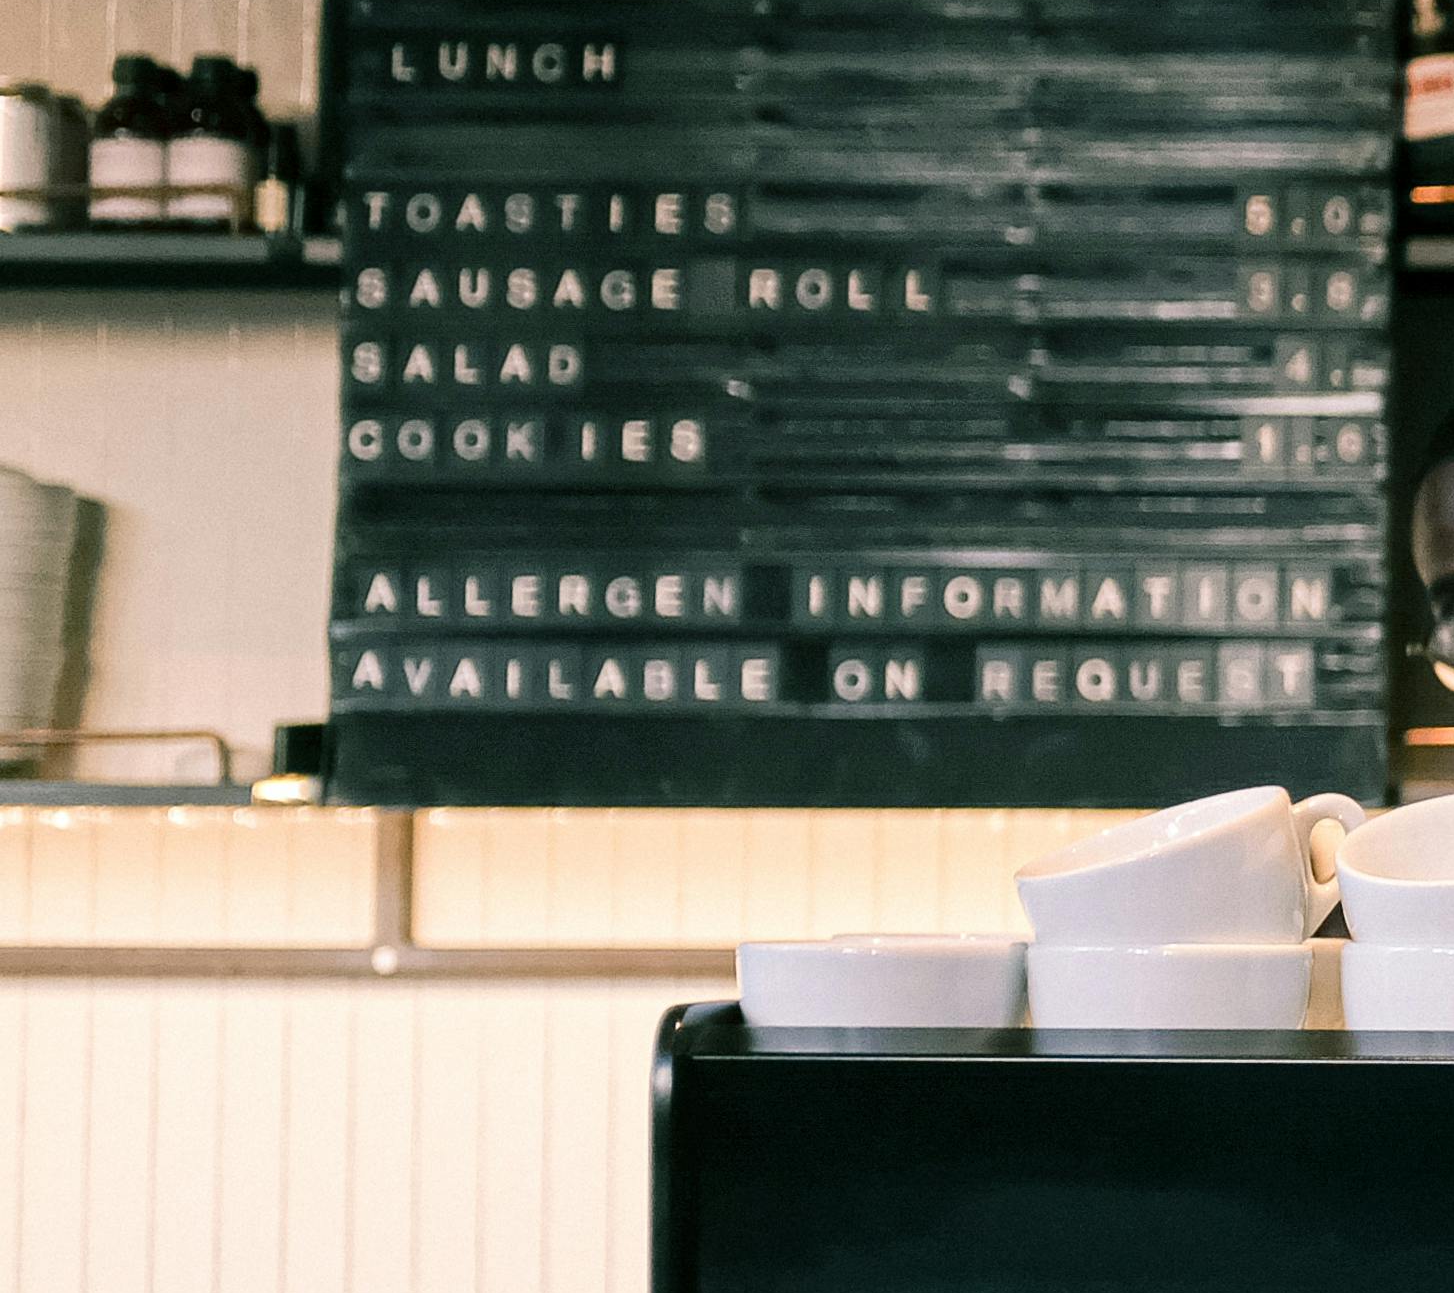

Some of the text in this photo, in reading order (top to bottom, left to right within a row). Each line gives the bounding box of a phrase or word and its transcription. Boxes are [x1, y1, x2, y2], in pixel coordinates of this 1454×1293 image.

[392, 42, 616, 83] LUNCH
[363, 192, 738, 234] TOASTIES
[356, 267, 682, 312] SAUSAGE
[749, 268, 932, 312] ROLL
[351, 341, 582, 385] SALAD
[348, 419, 705, 463] COOKIES
[364, 572, 1329, 624] ALLERGEN INFORMATION
[351, 650, 1310, 705] AVAILABLE ON REQUEST
